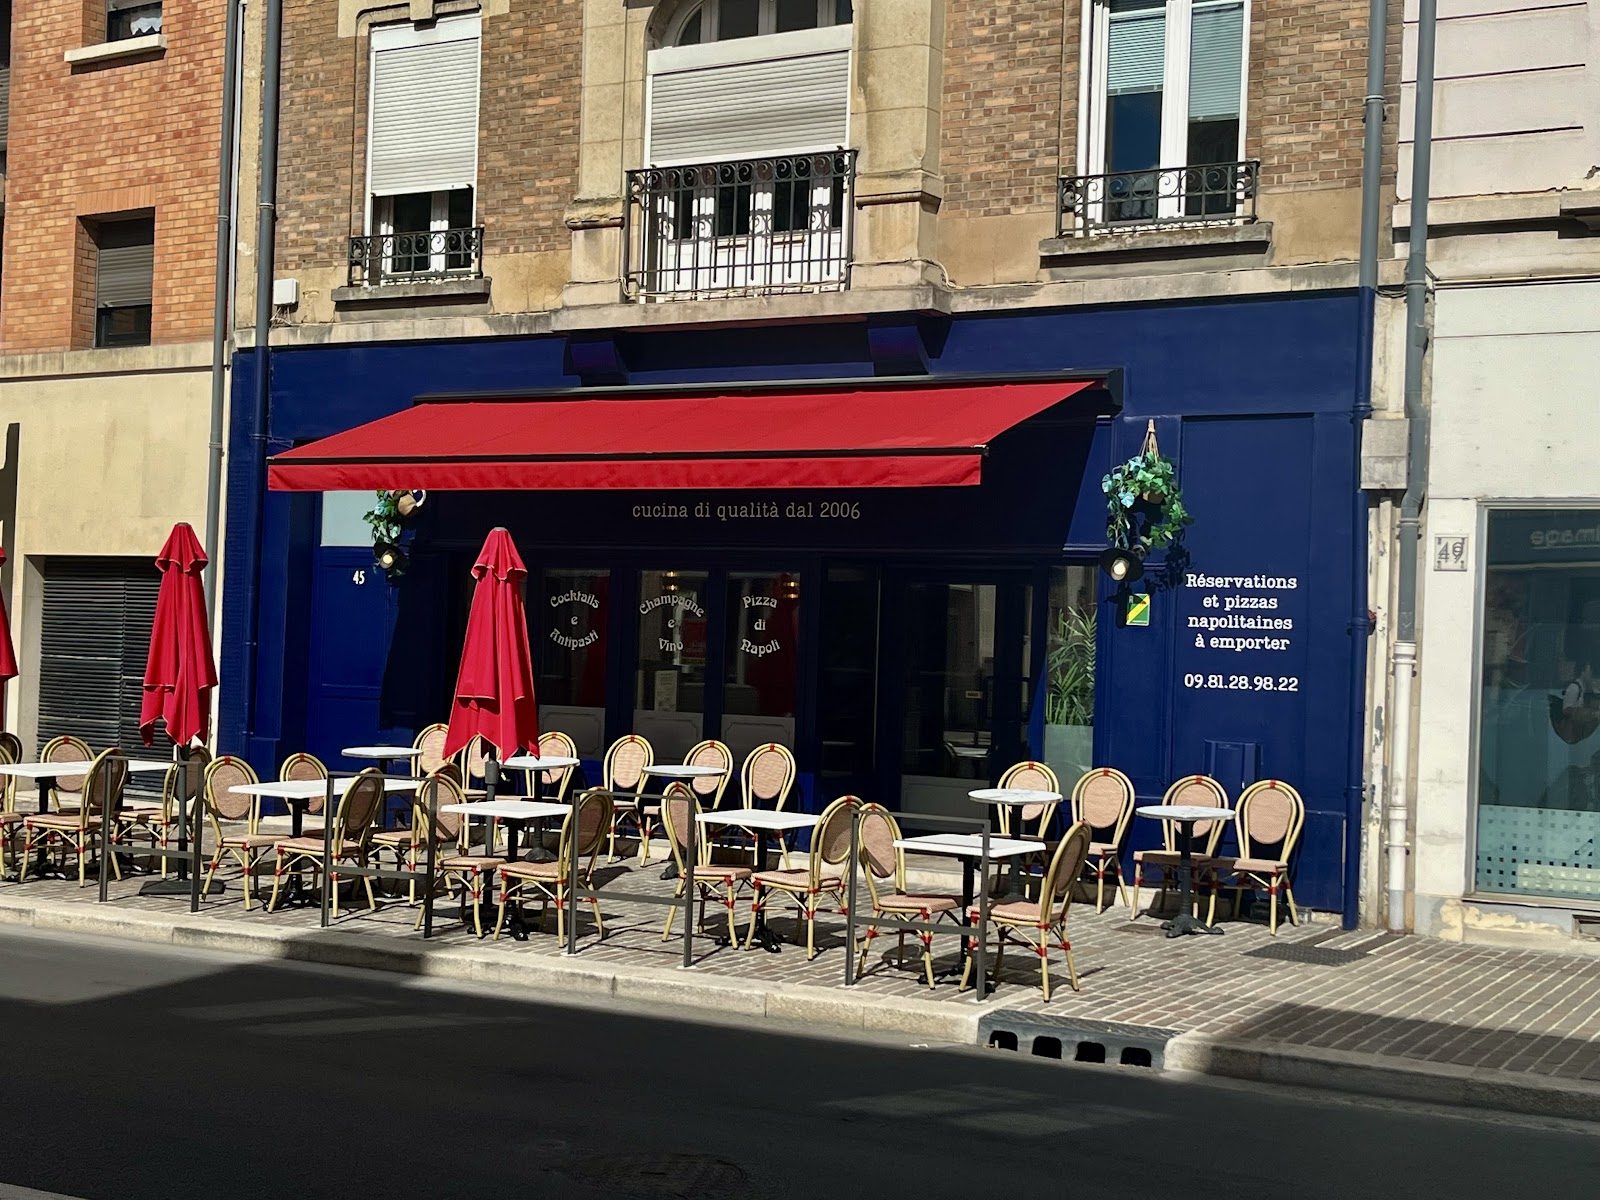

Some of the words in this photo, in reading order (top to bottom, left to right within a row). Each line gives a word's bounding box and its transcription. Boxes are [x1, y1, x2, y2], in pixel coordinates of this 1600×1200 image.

[632, 502, 689, 518] cucina
[694, 502, 711, 518] di
[717, 501, 780, 521] qualità
[785, 502, 814, 518] dal
[819, 501, 861, 520] 2006
[352, 570, 365, 585] 45
[1185, 573, 1298, 589] Réservations
[550, 589, 600, 609] Cocktails
[639, 594, 705, 618] Champagne
[742, 595, 778, 609] Pizza
[1202, 594, 1220, 608] et
[1223, 594, 1278, 612] pizzas
[570, 616, 578, 625] e
[667, 619, 675, 628] e
[753, 618, 766, 631] di
[1187, 614, 1293, 631] napolitaines
[549, 628, 599, 651] Antipasti
[658, 637, 684, 652] Vino
[740, 638, 781, 658] Napoli
[1194, 633, 1206, 649] à
[1209, 635, 1291, 652] emporter
[1184, 673, 1299, 692] 09.81.28.98.22
